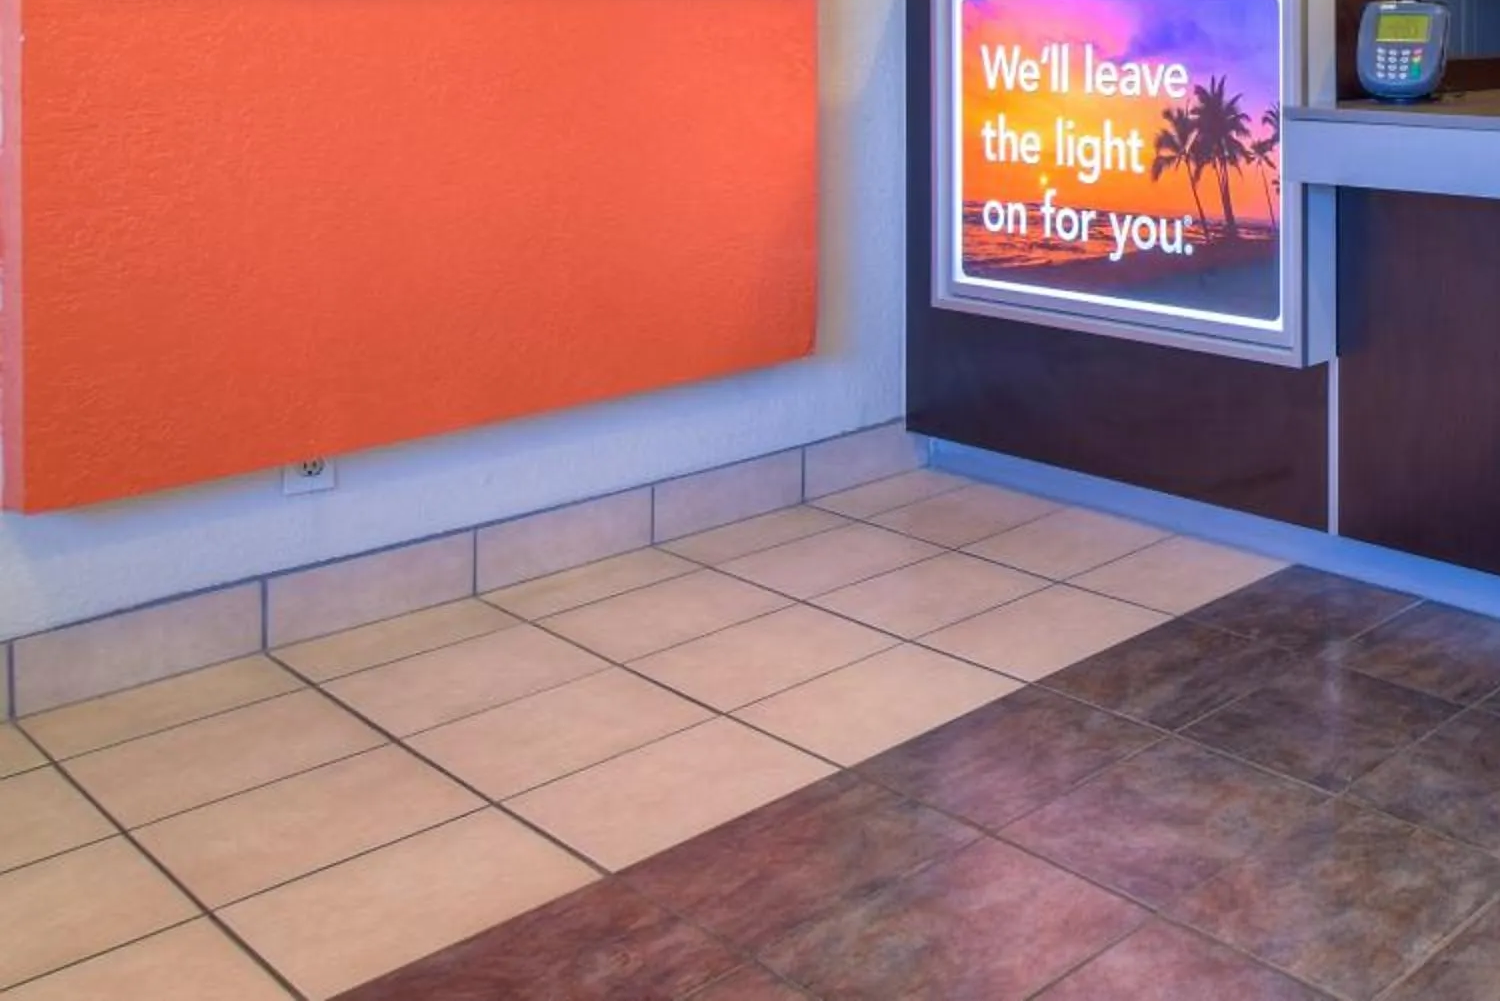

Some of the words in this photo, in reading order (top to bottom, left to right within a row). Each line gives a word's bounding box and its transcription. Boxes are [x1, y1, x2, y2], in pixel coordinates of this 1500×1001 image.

[980, 43, 1069, 93] We'll
[1084, 43, 1189, 98] leave
[981, 113, 1041, 164] the
[1055, 116, 1145, 183] light
[982, 199, 1027, 235] on
[1040, 189, 1097, 241] for
